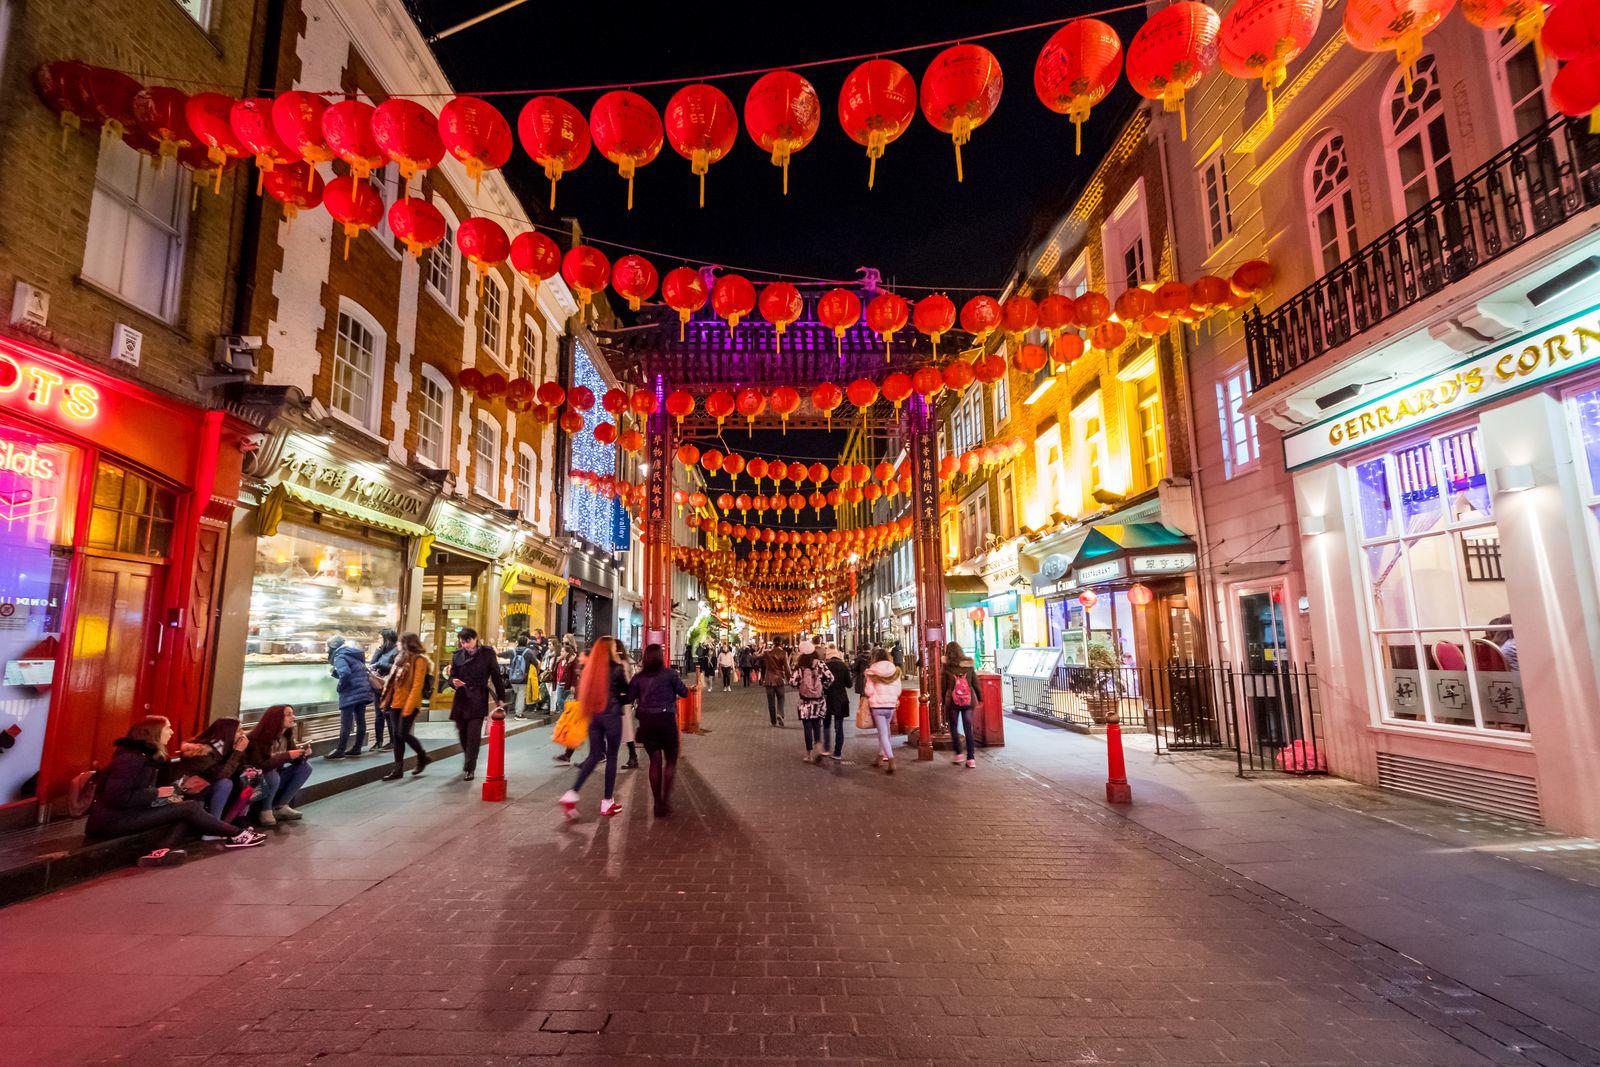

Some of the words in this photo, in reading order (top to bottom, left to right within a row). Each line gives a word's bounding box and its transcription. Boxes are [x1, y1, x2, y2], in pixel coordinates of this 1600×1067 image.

[1329, 367, 1484, 446] GERRARD'S
[351, 474, 422, 515] KOWLOON
[618, 517, 626, 539] valley
